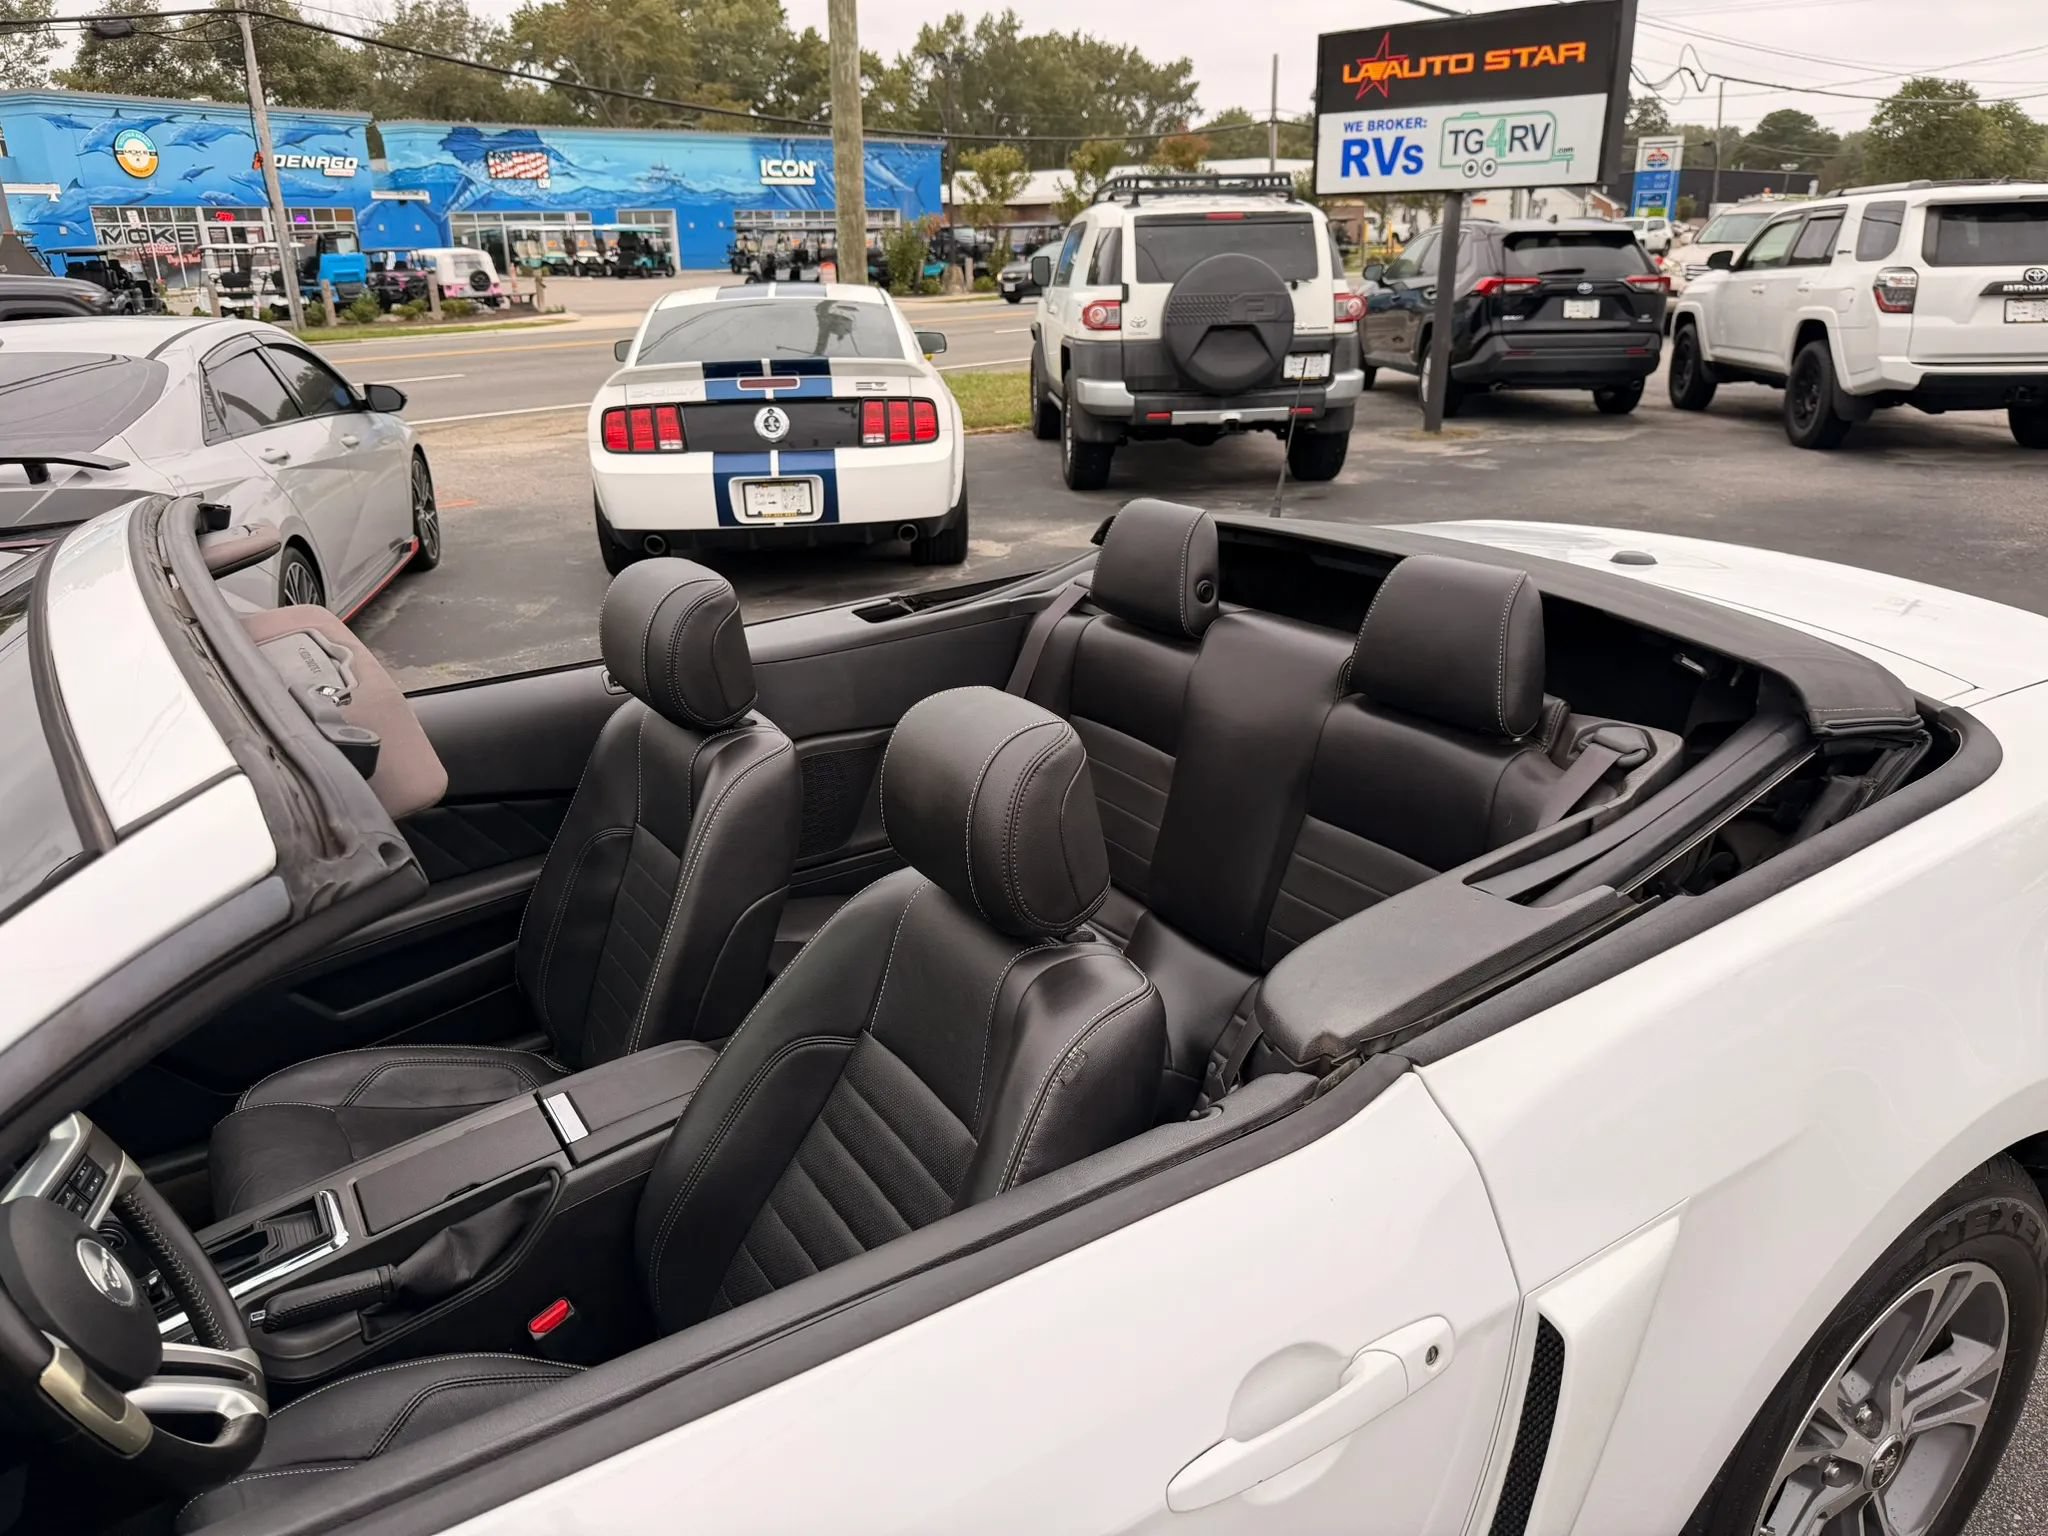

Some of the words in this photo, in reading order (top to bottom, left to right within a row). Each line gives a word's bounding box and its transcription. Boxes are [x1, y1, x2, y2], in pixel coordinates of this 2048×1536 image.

[1483, 41, 1587, 72] STAR
[1343, 121, 1364, 133] WE
[1367, 117, 1428, 131] BROKER:
[273, 154, 359, 169] DENAGO
[1340, 136, 1425, 178] RVs
[760, 159, 815, 178] ICON
[100, 226, 197, 245] MOKE
